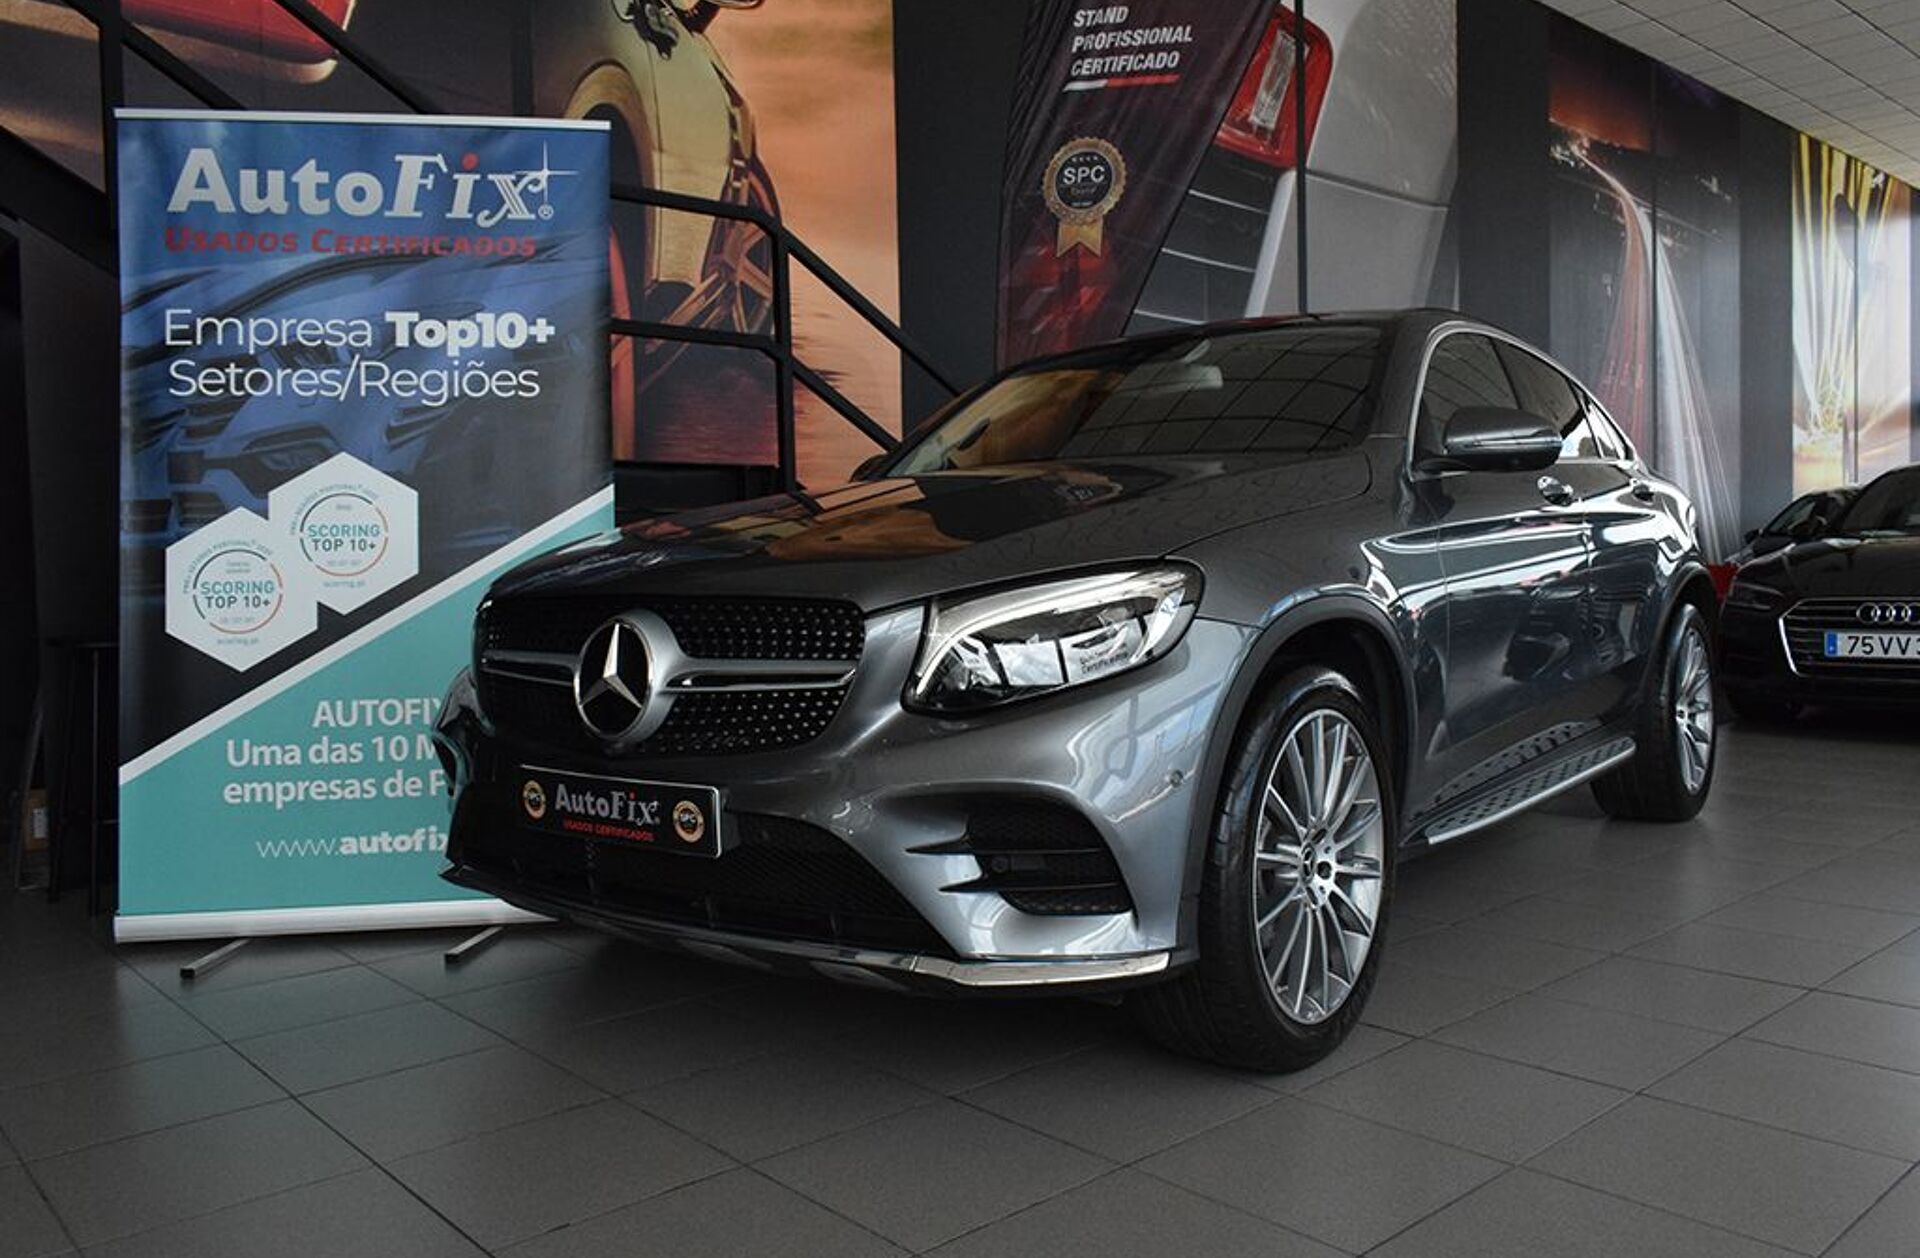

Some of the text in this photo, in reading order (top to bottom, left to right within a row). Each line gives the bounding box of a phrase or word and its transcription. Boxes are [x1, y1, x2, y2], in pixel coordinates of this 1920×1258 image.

[1073, 6, 1129, 28] STAND
[1071, 25, 1193, 52] PROFISSIONAL
[1071, 51, 1180, 76] CERTIFICADO
[1062, 165, 1106, 185] SPC
[164, 308, 556, 357] Empresa Top10+
[168, 353, 541, 408] Setores/Regiões
[307, 523, 381, 539] SCORING
[311, 538, 377, 552] TOP 10+
[201, 580, 275, 594] SCORING
[206, 594, 271, 609] TOP 10+
[1847, 635, 1874, 655] 75
[1878, 636, 1911, 656] VV
[226, 738, 302, 768] Uma
[308, 735, 364, 766] das
[371, 734, 410, 763] 10
[223, 775, 377, 811] empresas
[383, 768, 423, 798] de
